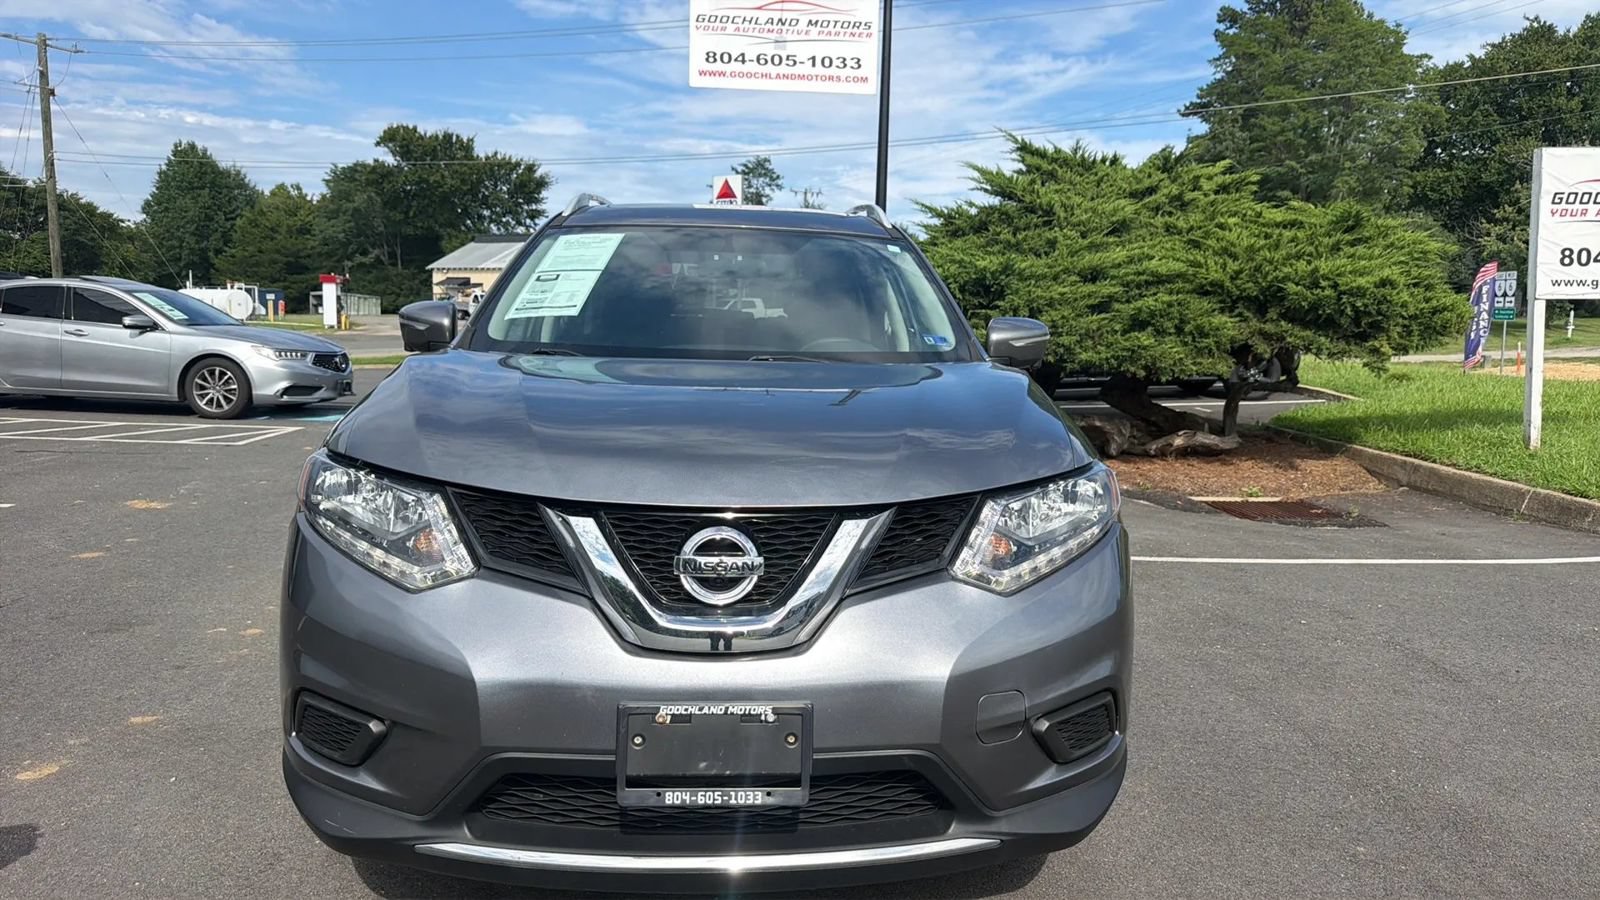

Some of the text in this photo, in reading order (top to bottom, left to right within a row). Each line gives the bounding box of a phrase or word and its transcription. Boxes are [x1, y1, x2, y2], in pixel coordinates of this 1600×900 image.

[695, 14, 873, 31] GOOCHLAND MOTORS
[695, 25, 873, 39] YOUR AUTOMOTIVE PARTNER
[705, 50, 862, 70] 804-605-1033
[698, 69, 869, 84] WWW.GOOCHLANDMOTORS.COM
[1550, 208, 1589, 218] YOUR
[683, 559, 755, 573] NISSAN
[659, 705, 773, 715] GOOCHLAND MOTORS
[665, 791, 762, 804] 804-605-1033
